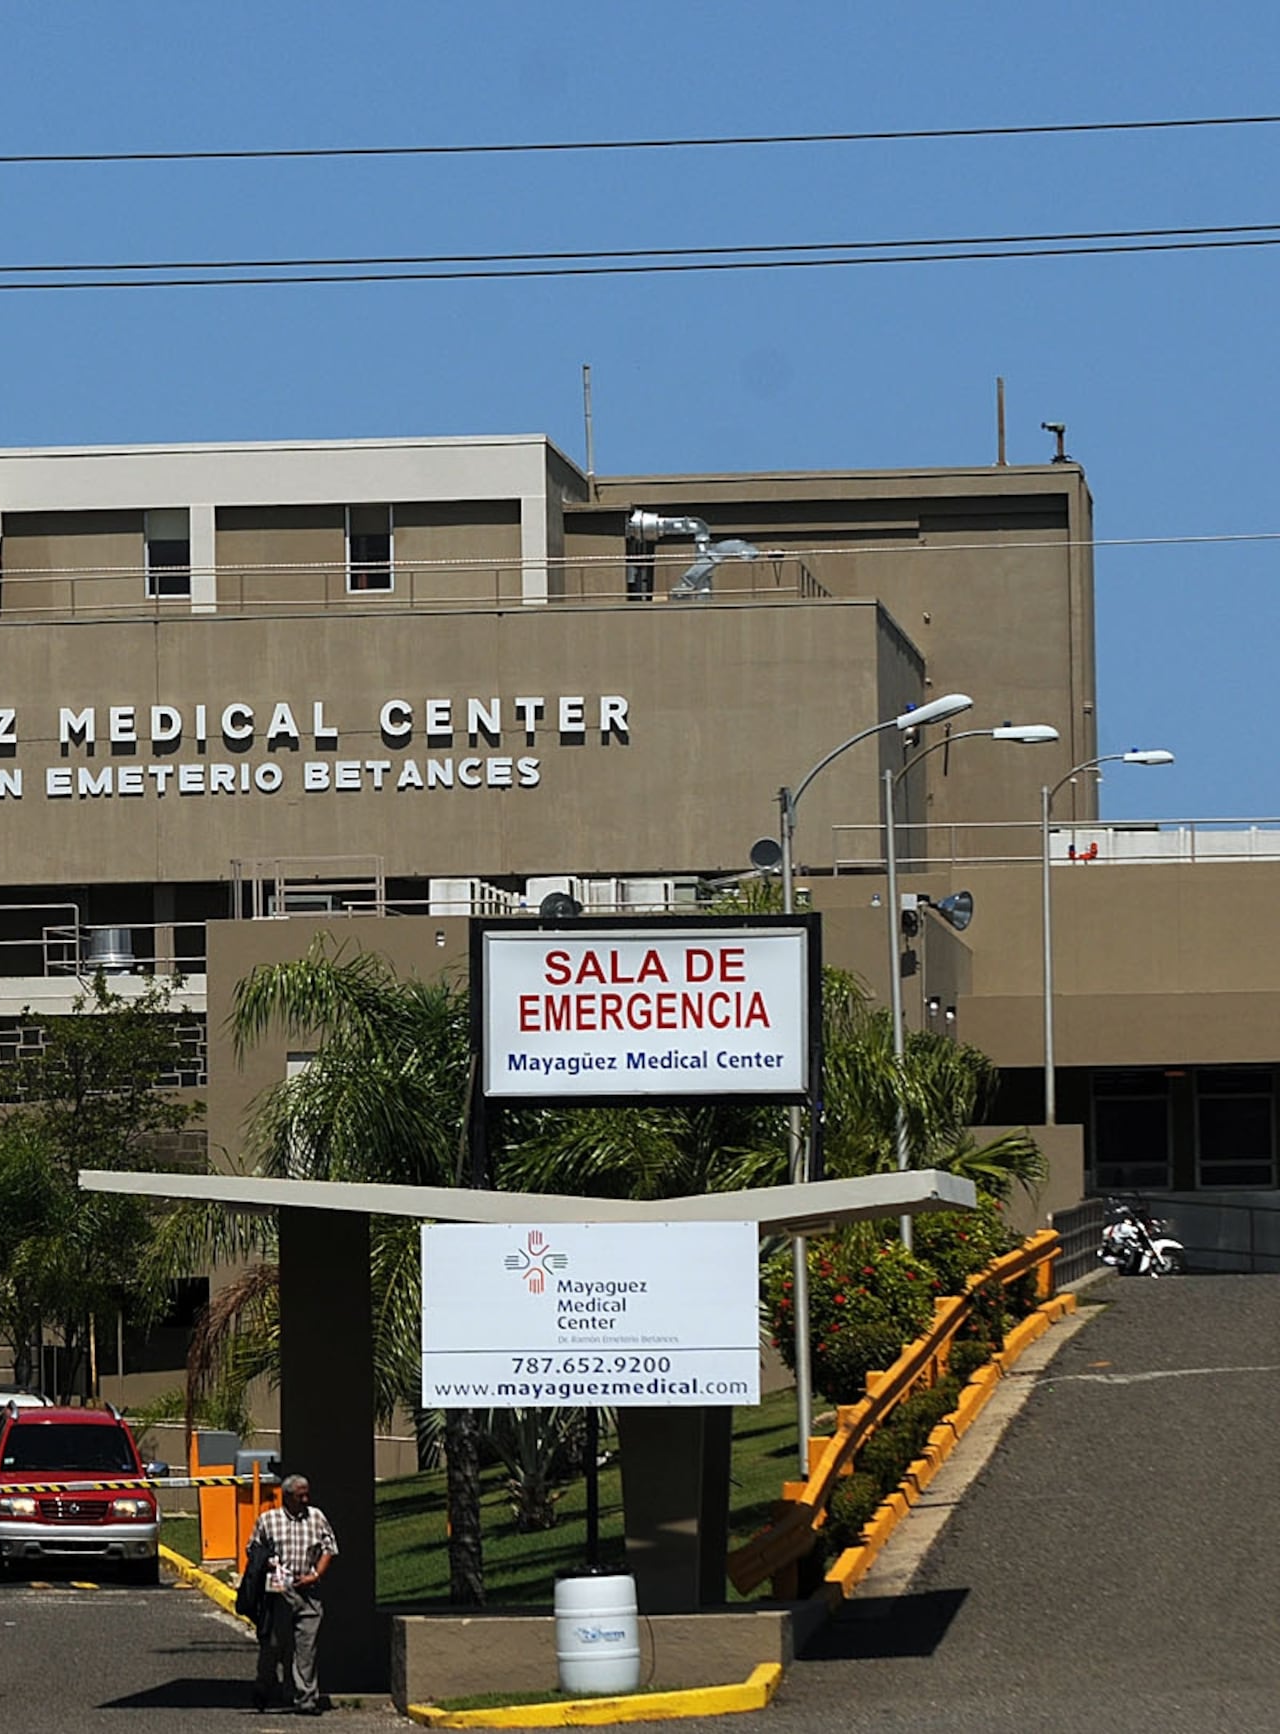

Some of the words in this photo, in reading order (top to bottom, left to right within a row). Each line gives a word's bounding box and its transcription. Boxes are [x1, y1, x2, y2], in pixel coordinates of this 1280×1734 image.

[59, 702, 338, 743] MEDICAL
[380, 696, 629, 735] CENTER
[46, 762, 283, 796] EMETERIO
[304, 757, 540, 790] BETANCES
[545, 950, 669, 984] SALA
[686, 948, 746, 982] DE
[519, 992, 770, 1031] EMERGENCIA
[508, 1052, 617, 1075] Mayagüez
[626, 1050, 708, 1069] Medical
[716, 1050, 784, 1069] Center
[557, 1279, 647, 1297] Mayaguez
[557, 1297, 626, 1312] Medical
[557, 1316, 617, 1330] Center
[511, 1357, 671, 1374] 787.652.9200
[434, 1378, 748, 1399] www.mayaguezmedical.com
